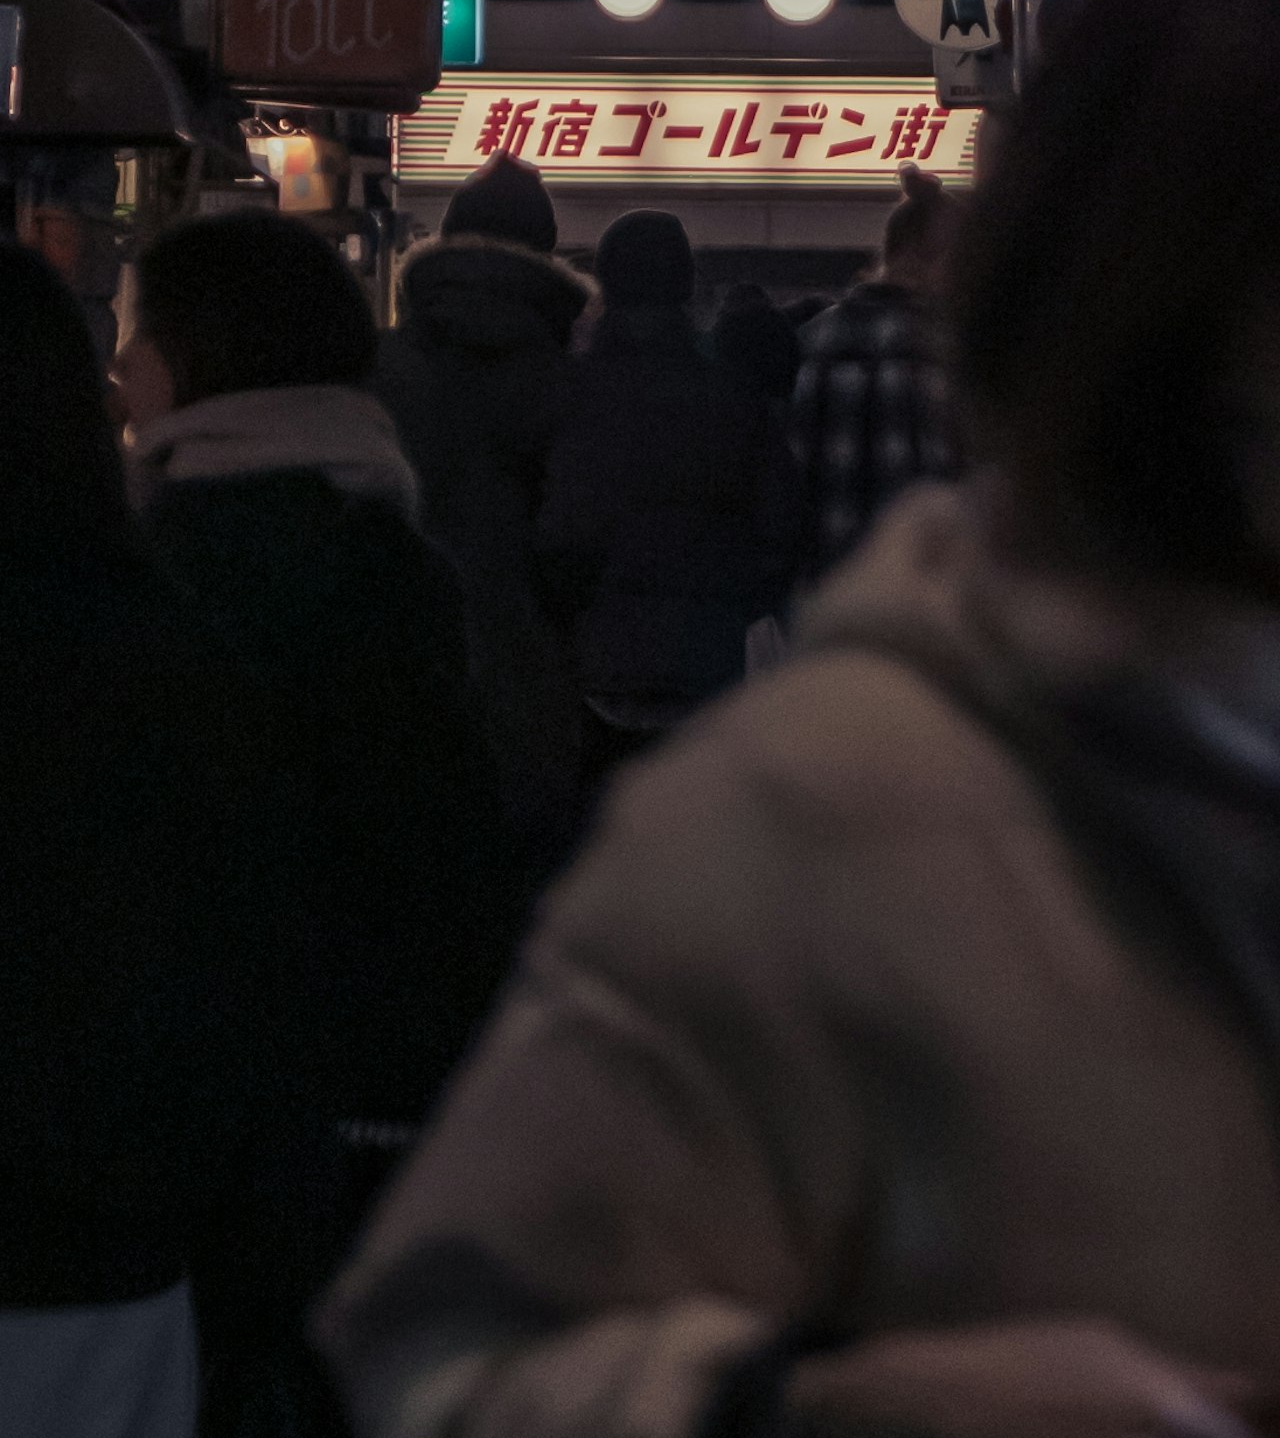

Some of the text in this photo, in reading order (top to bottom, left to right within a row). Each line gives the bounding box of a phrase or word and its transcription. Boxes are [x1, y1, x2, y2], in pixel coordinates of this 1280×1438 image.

[476, 98, 950, 160] 新宿ゴールデン街
